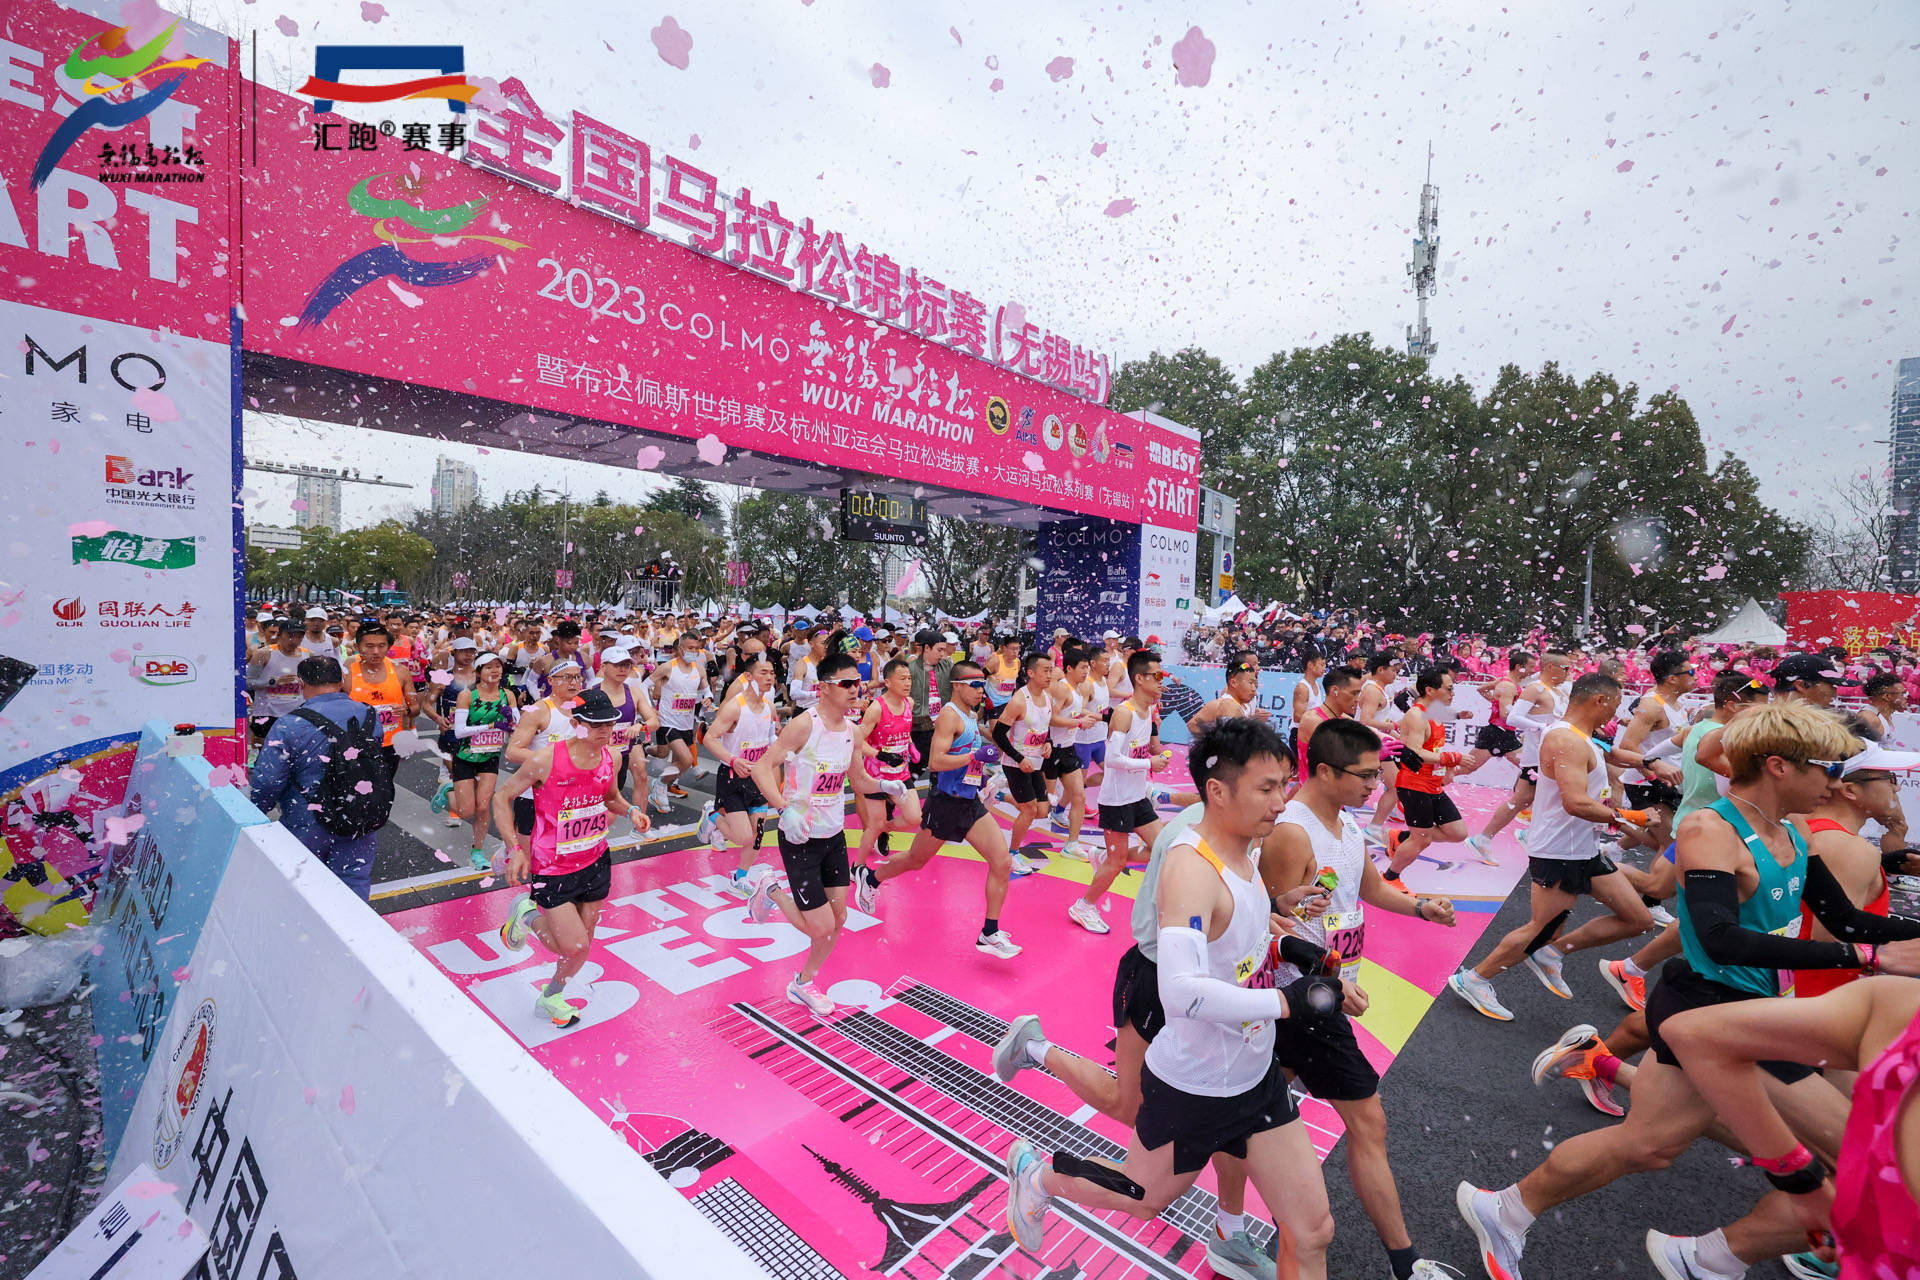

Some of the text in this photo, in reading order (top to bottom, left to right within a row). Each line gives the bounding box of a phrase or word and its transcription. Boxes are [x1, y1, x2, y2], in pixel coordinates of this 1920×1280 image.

[536, 258, 790, 362] 2023 COLMO
[802, 380, 975, 445] WUXI MARATHON
[1161, 444, 1196, 474] BEST
[105, 454, 195, 491] Bank
[106, 488, 196, 505] 中国光大银行
[1147, 476, 1196, 516] START
[874, 532, 905, 543] SUUNTO
[1053, 529, 1122, 547] COLMO
[1151, 534, 1190, 553] COLMO
[100, 620, 191, 628] GUOLIAN LIFE
[38, 663, 93, 676] 国移动
[28, 676, 54, 687] hina
[563, 814, 606, 840] 10743
